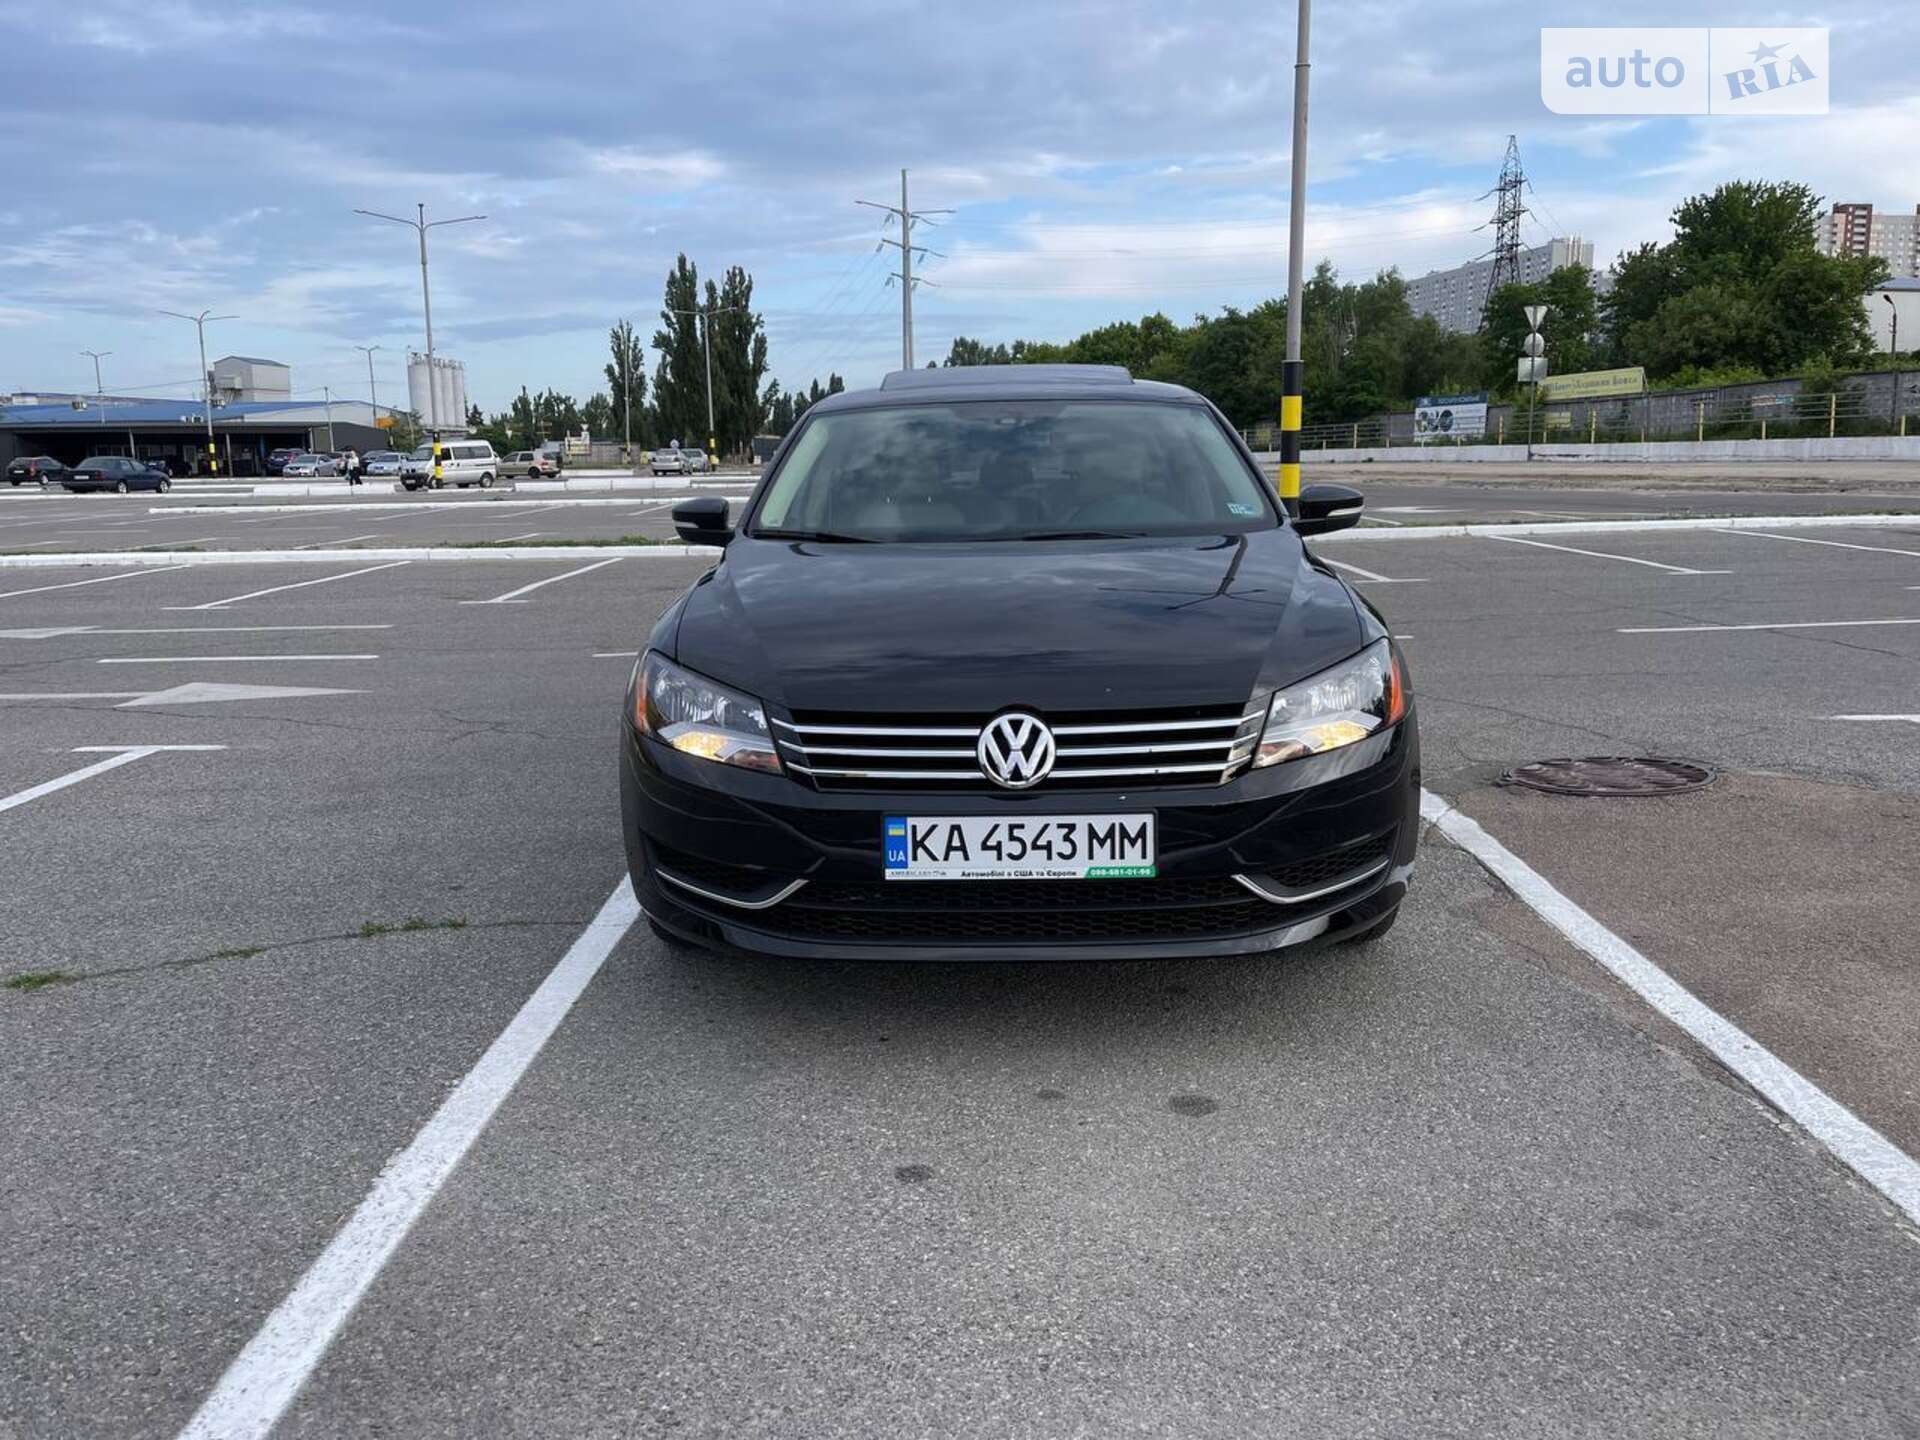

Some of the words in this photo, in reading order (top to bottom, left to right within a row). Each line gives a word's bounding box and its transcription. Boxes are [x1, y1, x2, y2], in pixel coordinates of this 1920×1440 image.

[980, 715, 1054, 787] VW
[888, 849, 906, 862] UA
[911, 823, 970, 862] KA
[980, 822, 1078, 861] 4543
[1087, 821, 1147, 861] MM
